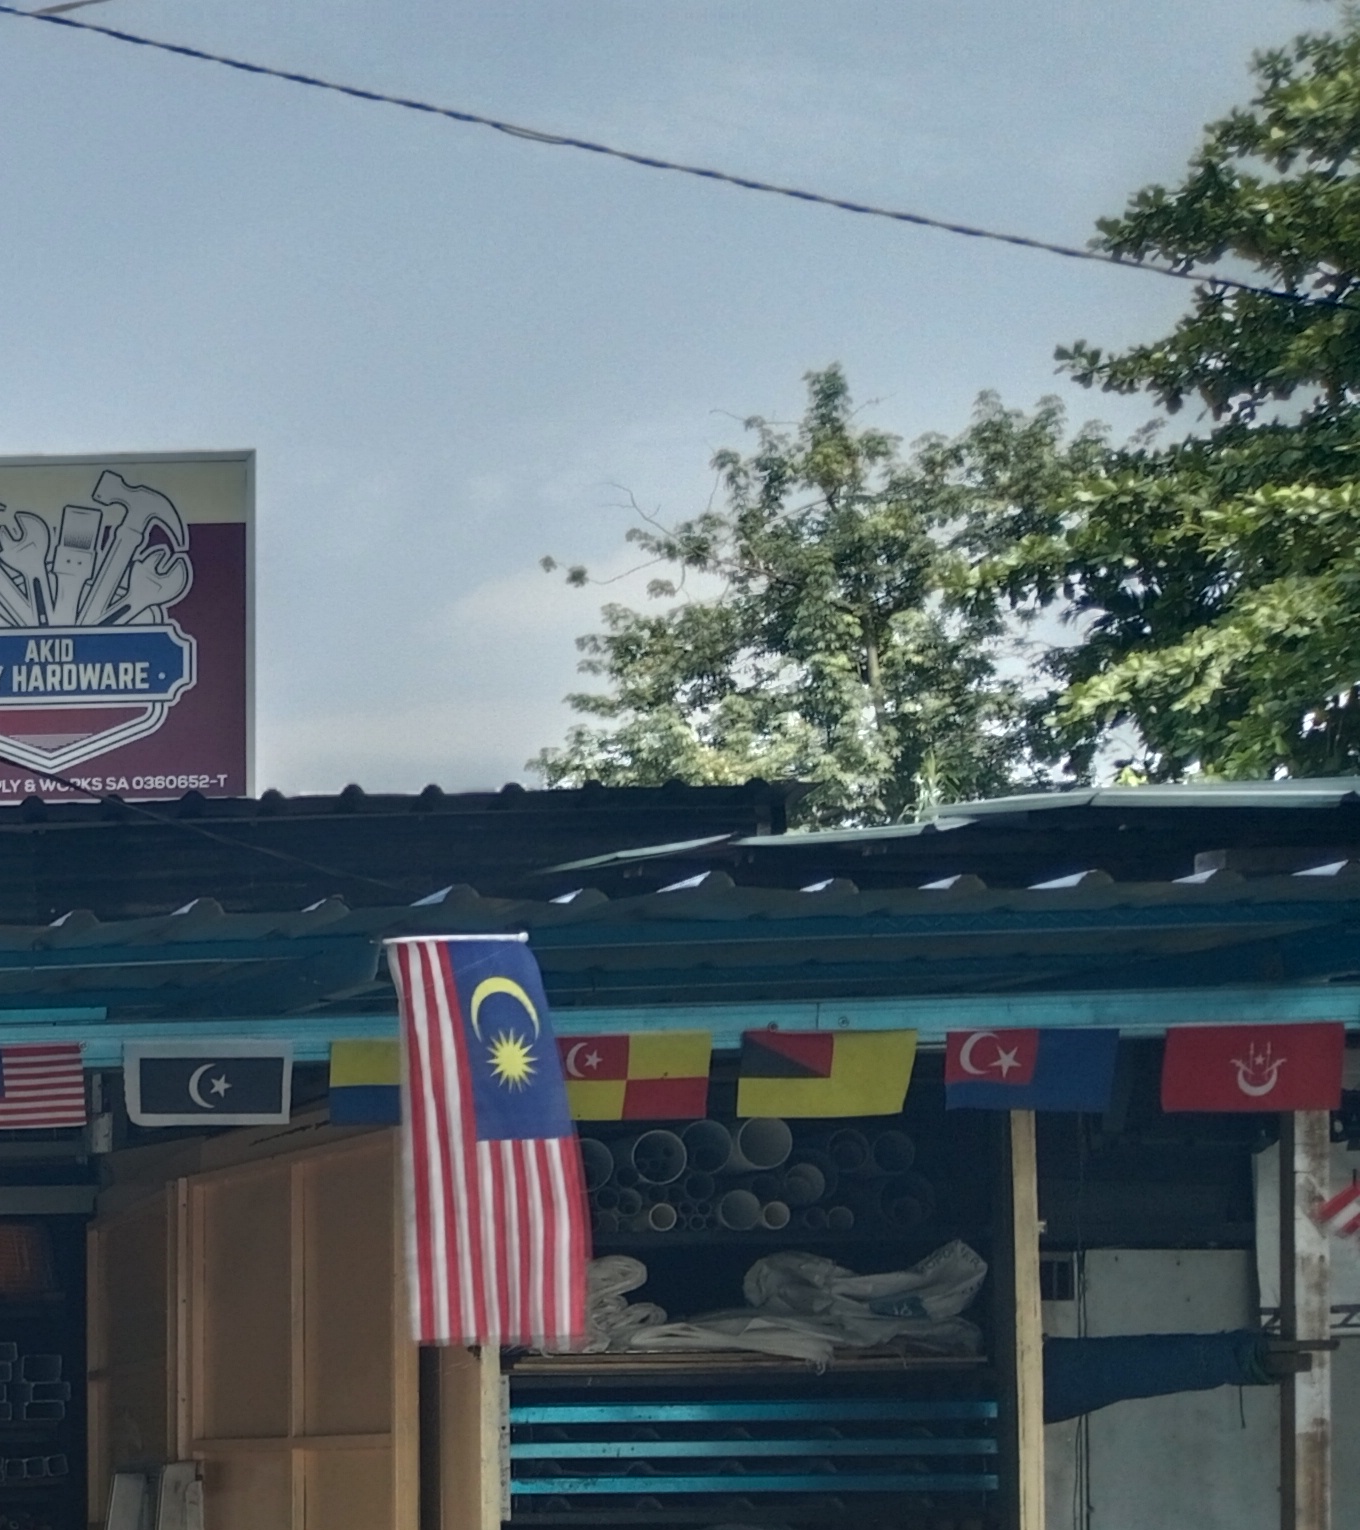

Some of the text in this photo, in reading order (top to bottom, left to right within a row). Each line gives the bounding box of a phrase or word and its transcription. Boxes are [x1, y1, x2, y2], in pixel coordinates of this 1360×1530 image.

[24, 638, 74, 663] AKID
[11, 662, 150, 692] HARDWARE
[24, 779, 35, 793] &
[105, 776, 130, 791] SA
[132, 774, 228, 790] 0360652-T
